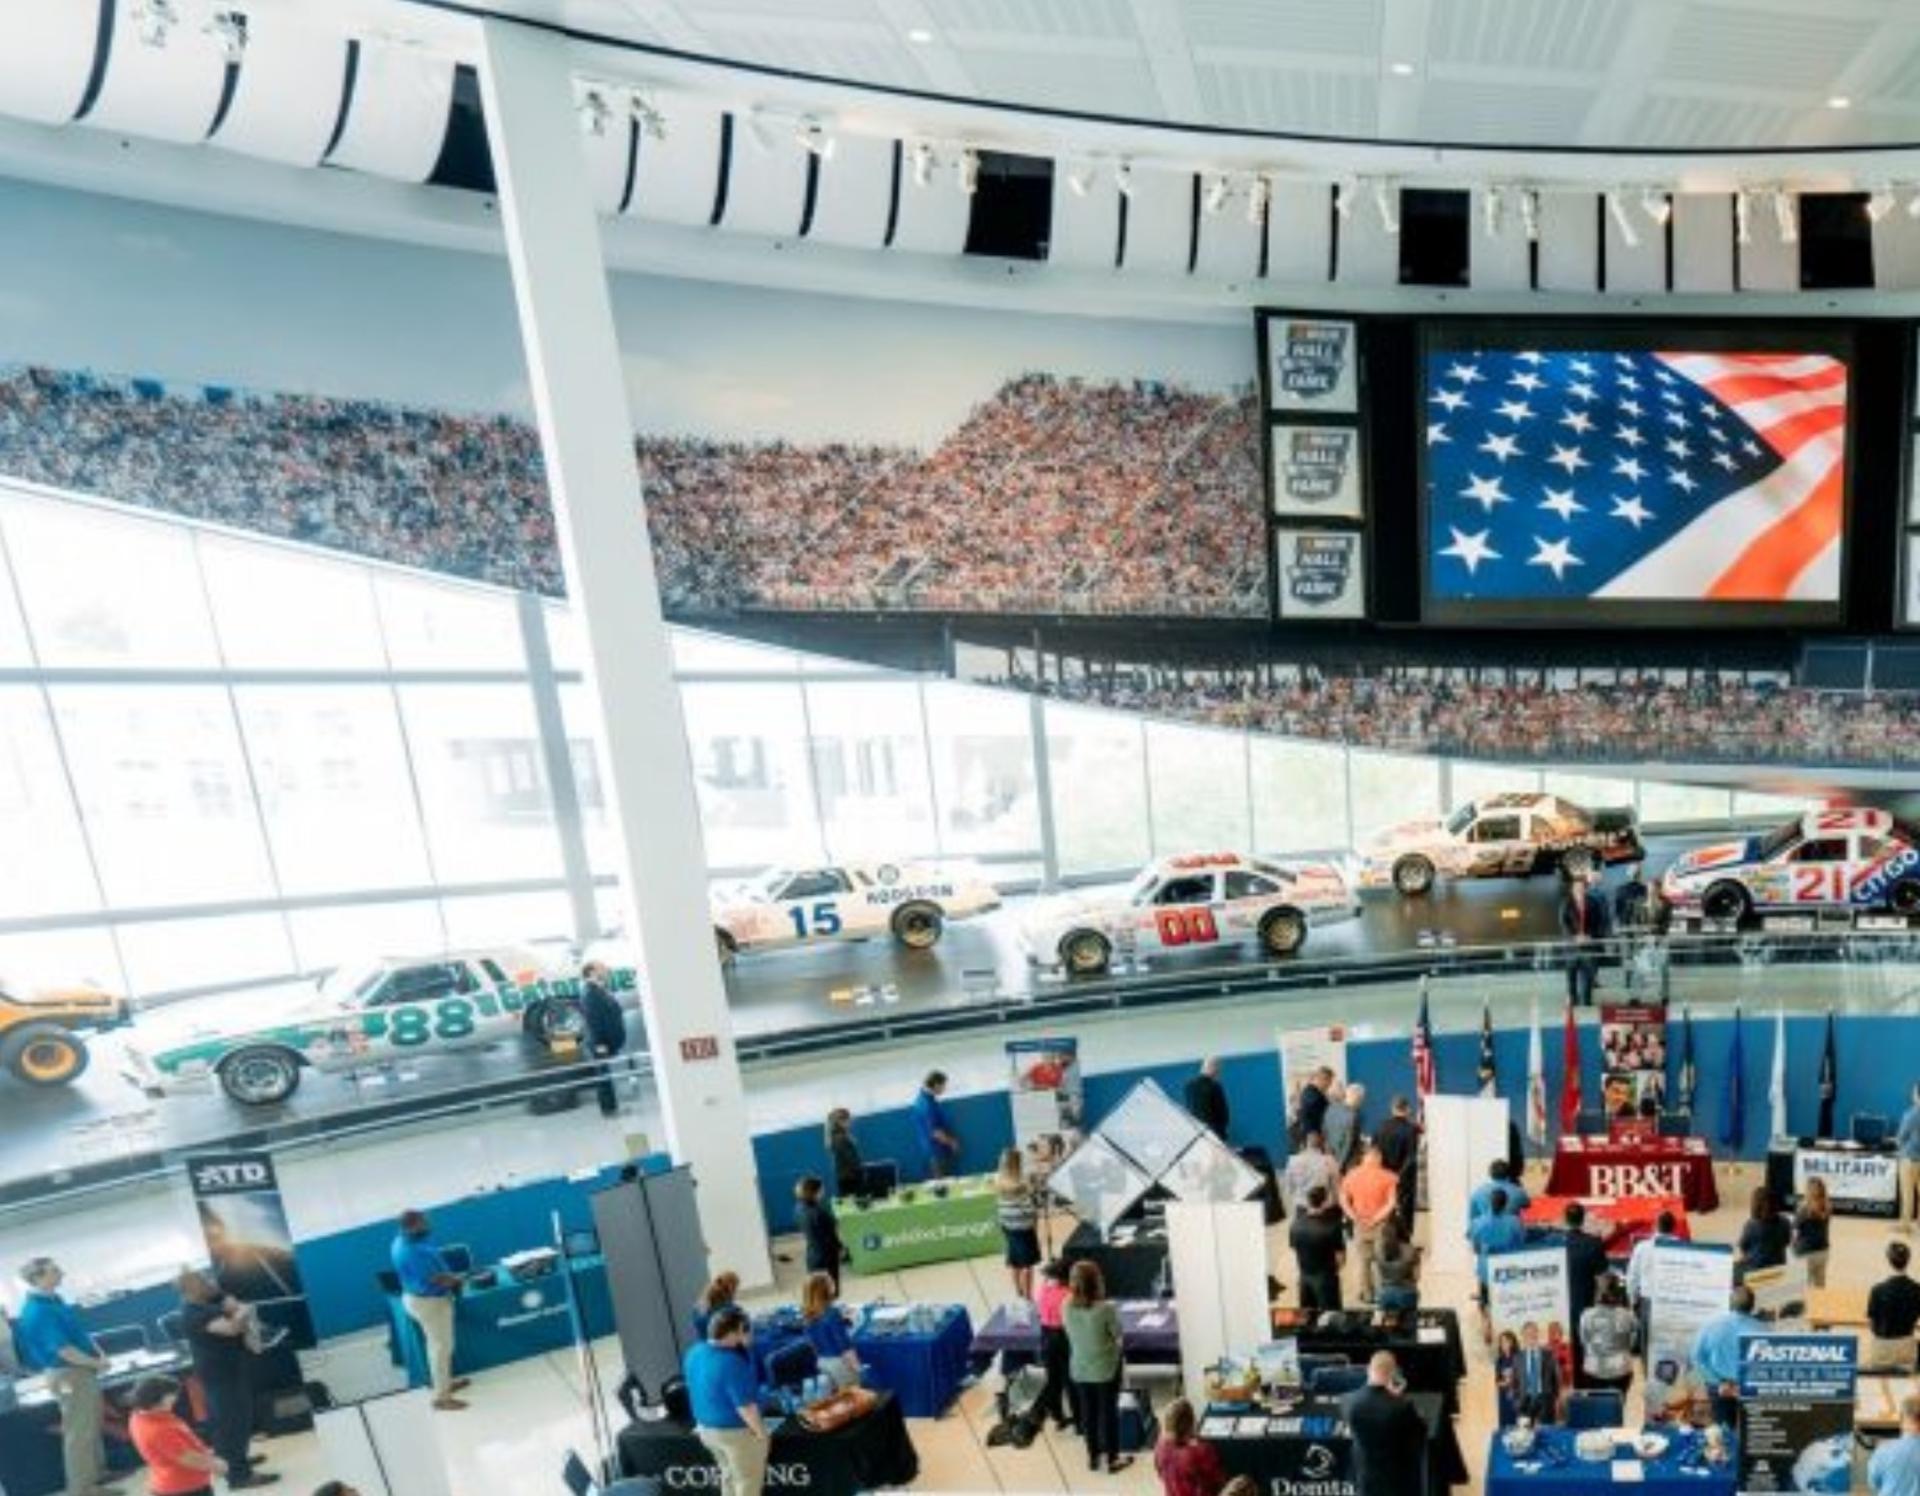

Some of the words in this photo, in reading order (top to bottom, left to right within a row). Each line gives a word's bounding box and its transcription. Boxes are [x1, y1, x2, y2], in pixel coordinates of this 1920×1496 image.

[1796, 865, 1843, 901] 21
[788, 902, 842, 939] 15
[1155, 907, 1218, 946] 00
[389, 998, 473, 1046] 88
[1588, 1162, 1691, 1200] BB&T
[1803, 1157, 1891, 1177] MILITARY
